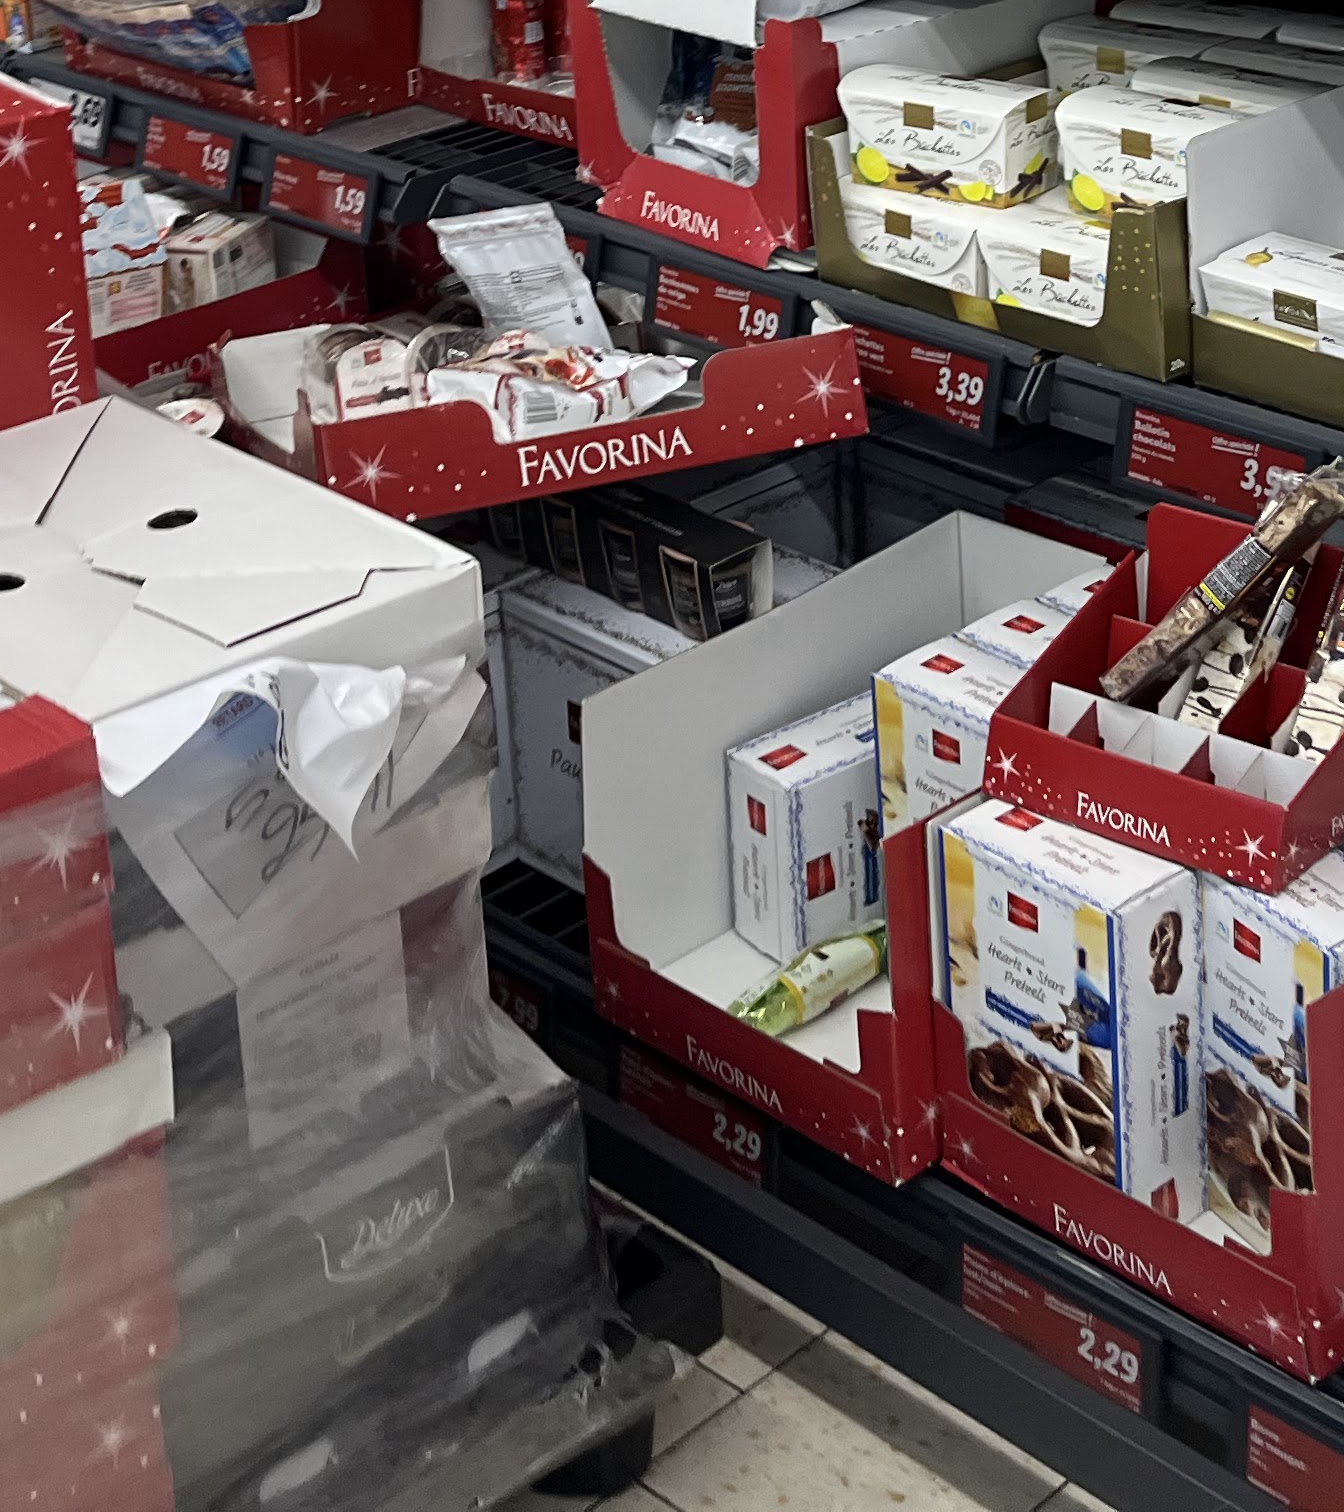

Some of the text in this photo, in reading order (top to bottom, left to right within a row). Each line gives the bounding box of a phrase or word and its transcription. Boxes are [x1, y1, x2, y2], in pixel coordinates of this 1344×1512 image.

[334, 187, 365, 215] 1,59
[641, 190, 719, 241] FAVORINA
[738, 304, 780, 340] 1,99
[45, 310, 81, 416] ORINA
[934, 366, 984, 406] 3,39
[517, 426, 693, 488] FAVORINA
[1076, 791, 1171, 848] FAVORINA
[686, 1034, 785, 1115] FAVORINA
[711, 1111, 762, 1161] 2,29
[1052, 1202, 1174, 1296] FAVORINA
[1077, 1326, 1140, 1385] 2,29
